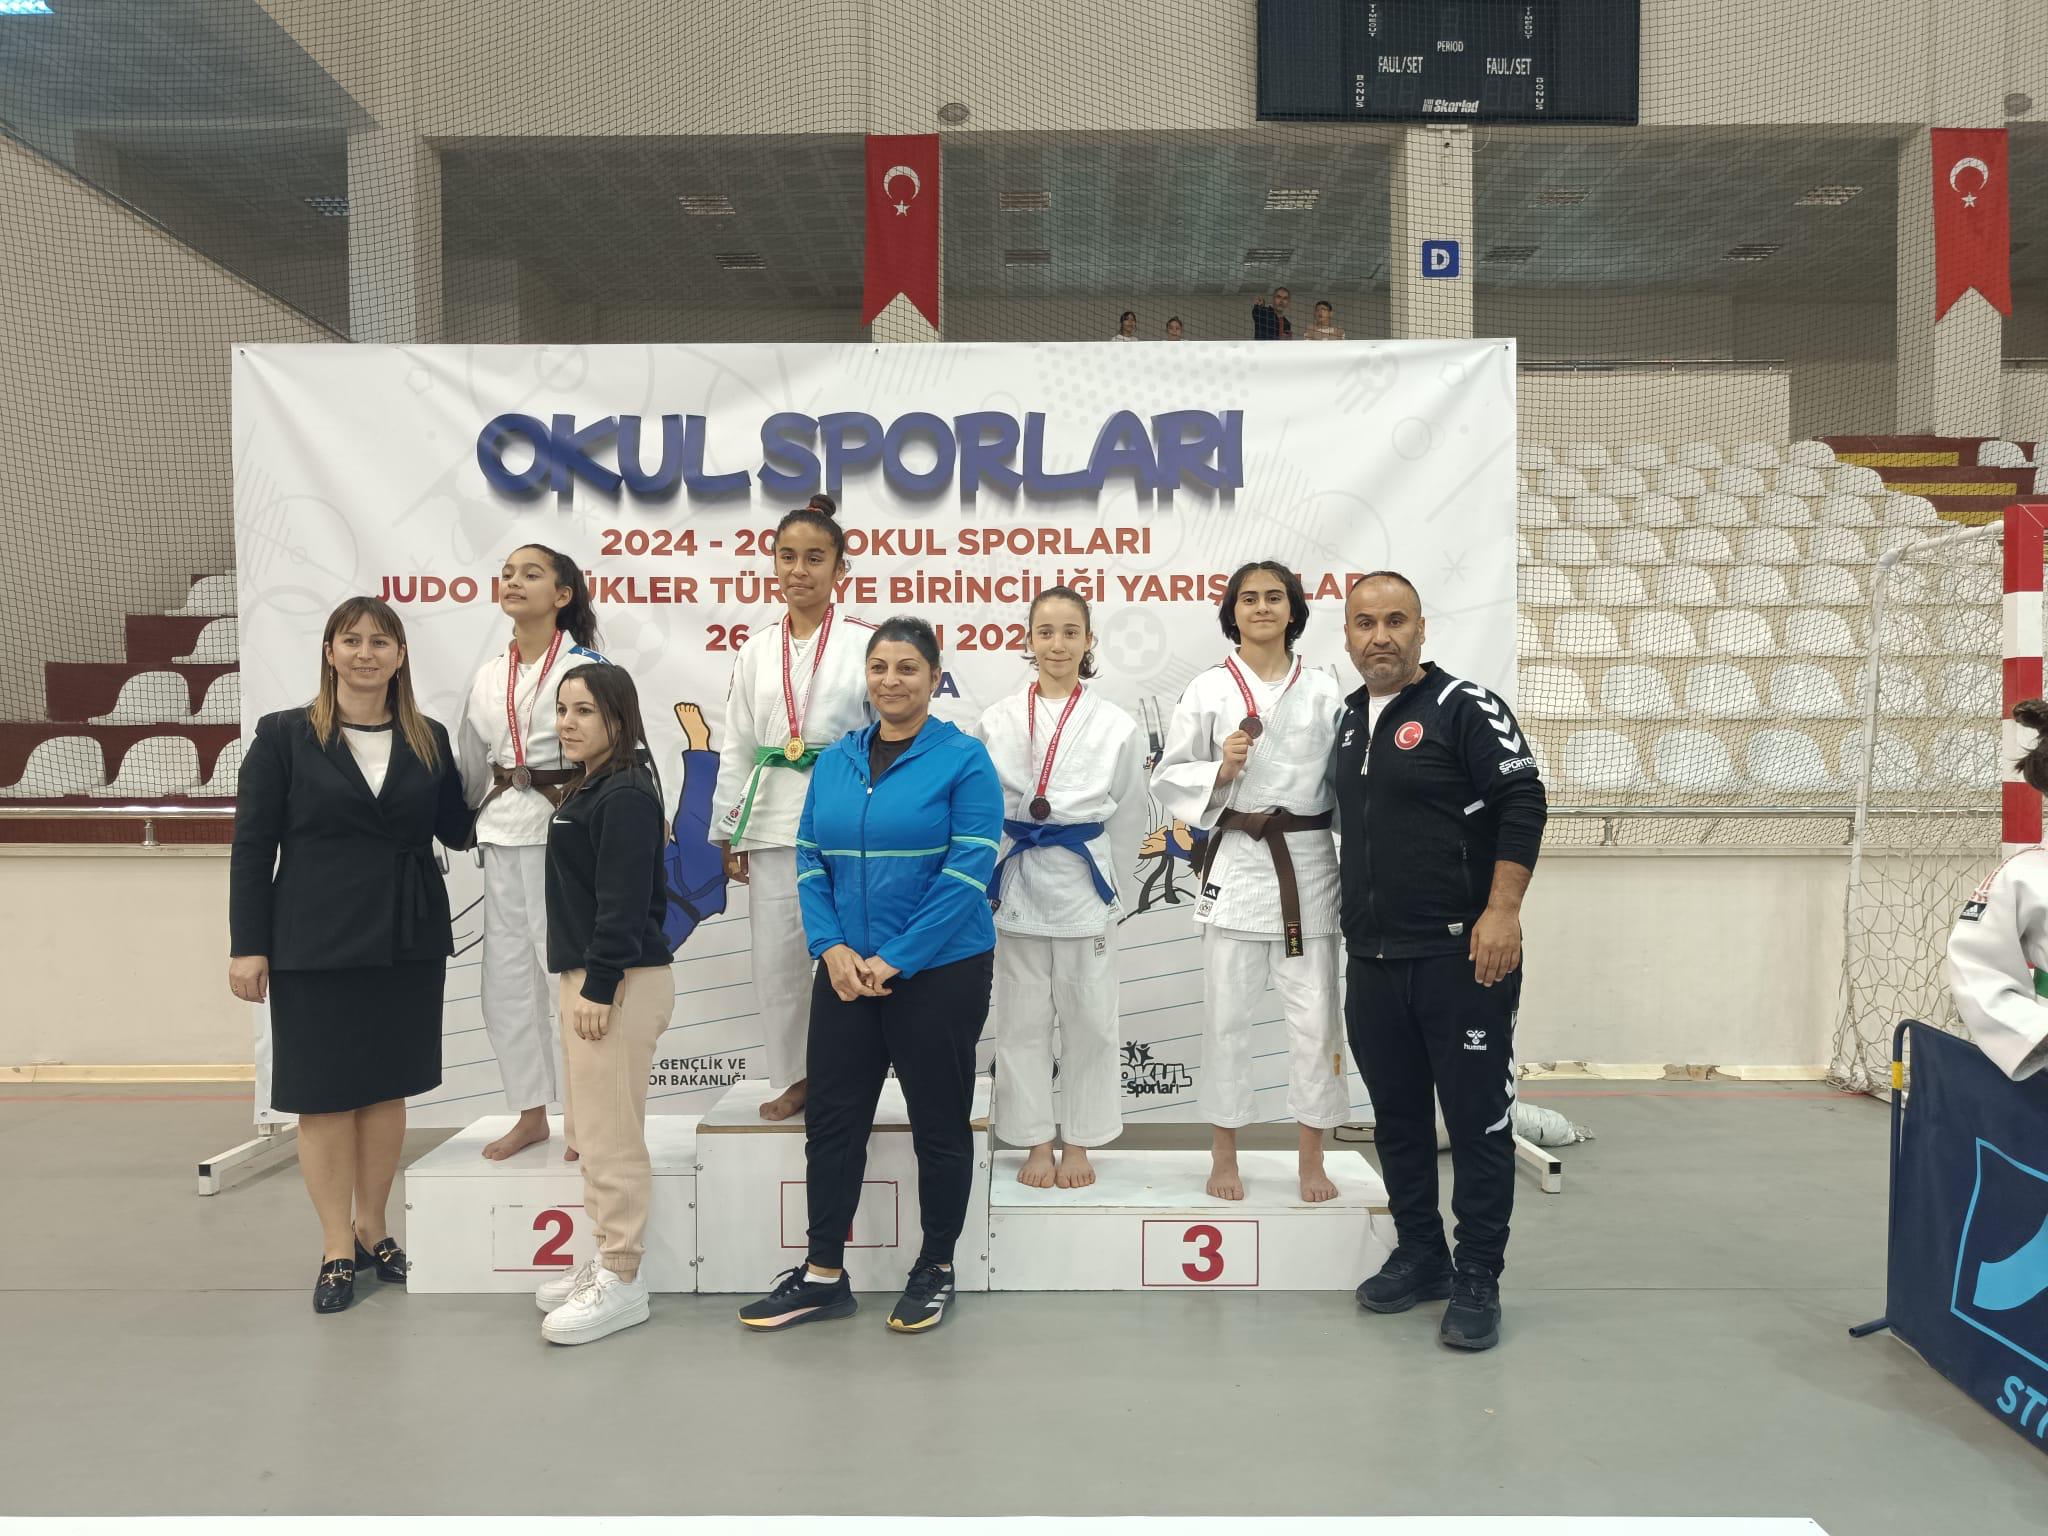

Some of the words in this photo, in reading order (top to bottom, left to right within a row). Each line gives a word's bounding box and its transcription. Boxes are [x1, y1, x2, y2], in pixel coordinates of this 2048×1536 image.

[1437, 41, 1464, 52] PERIOD
[1378, 56, 1423, 73] FAUL/SET
[1486, 58, 1532, 75] FAUL/SET
[1356, 75, 1364, 107] BONUS
[1536, 77, 1544, 110] BONUS
[1431, 249, 1450, 270] D
[477, 413, 751, 492] OKUL
[757, 411, 1244, 491] SPORLARI
[600, 529, 697, 556] 2024
[843, 529, 946, 556] OKUL
[957, 528, 1150, 555] SPORLARI
[376, 576, 478, 603] JUDO
[710, 571, 878, 604] TÜRYE
[706, 624, 749, 651] 26
[957, 624, 1026, 651] 202
[660, 1057, 722, 1072] GENÇLİK
[728, 1059, 745, 1069] VE
[533, 1210, 573, 1265] 2
[1182, 1225, 1224, 1282] 3
